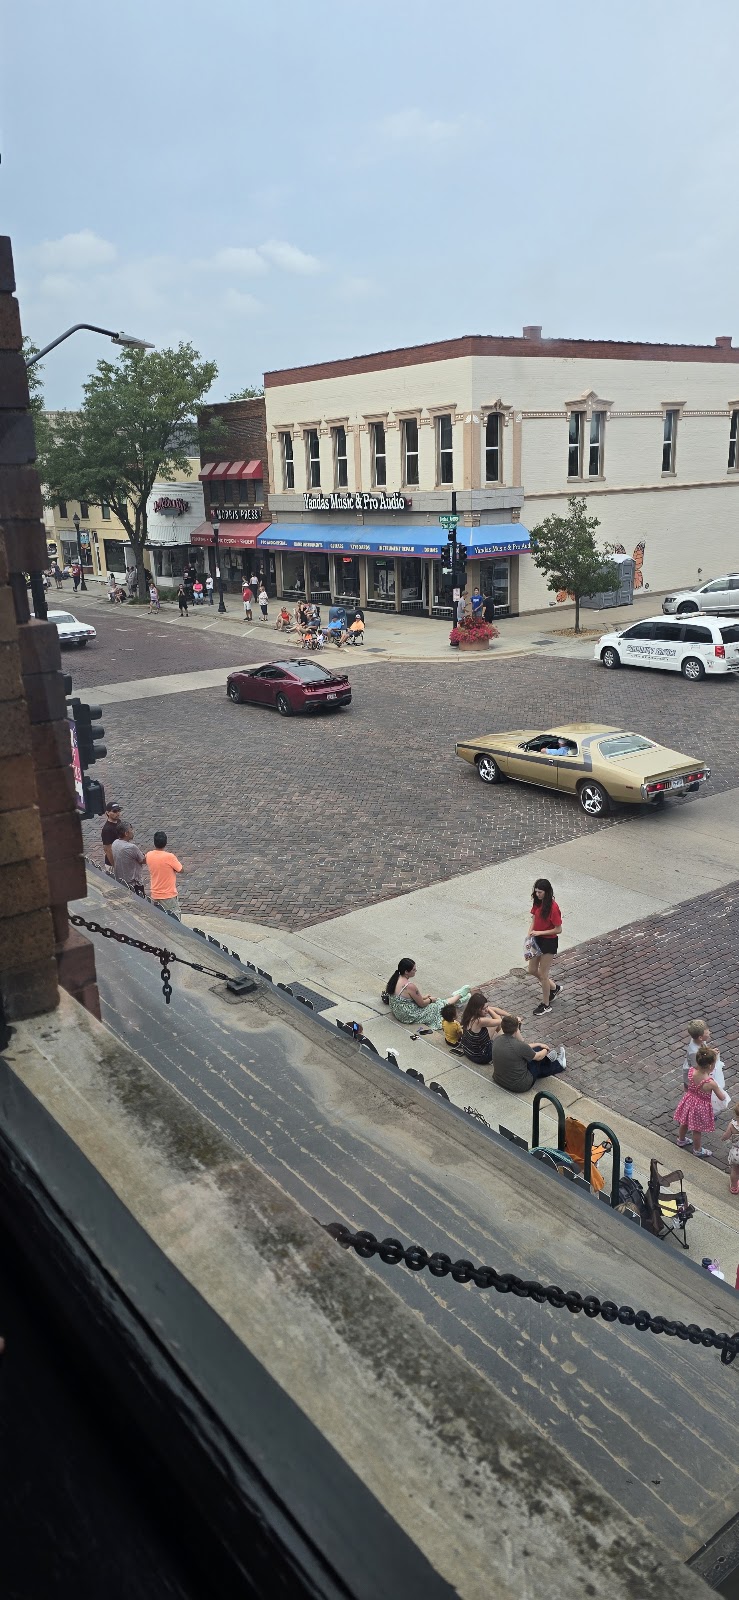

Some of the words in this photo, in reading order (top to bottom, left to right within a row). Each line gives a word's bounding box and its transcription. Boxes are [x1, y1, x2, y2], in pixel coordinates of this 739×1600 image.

[303, 493, 330, 510] Yandas
[330, 493, 355, 510] Music
[355, 493, 363, 509] &
[362, 493, 379, 510] Pro
[379, 492, 405, 510] Audio
[240, 509, 259, 520] PRESS
